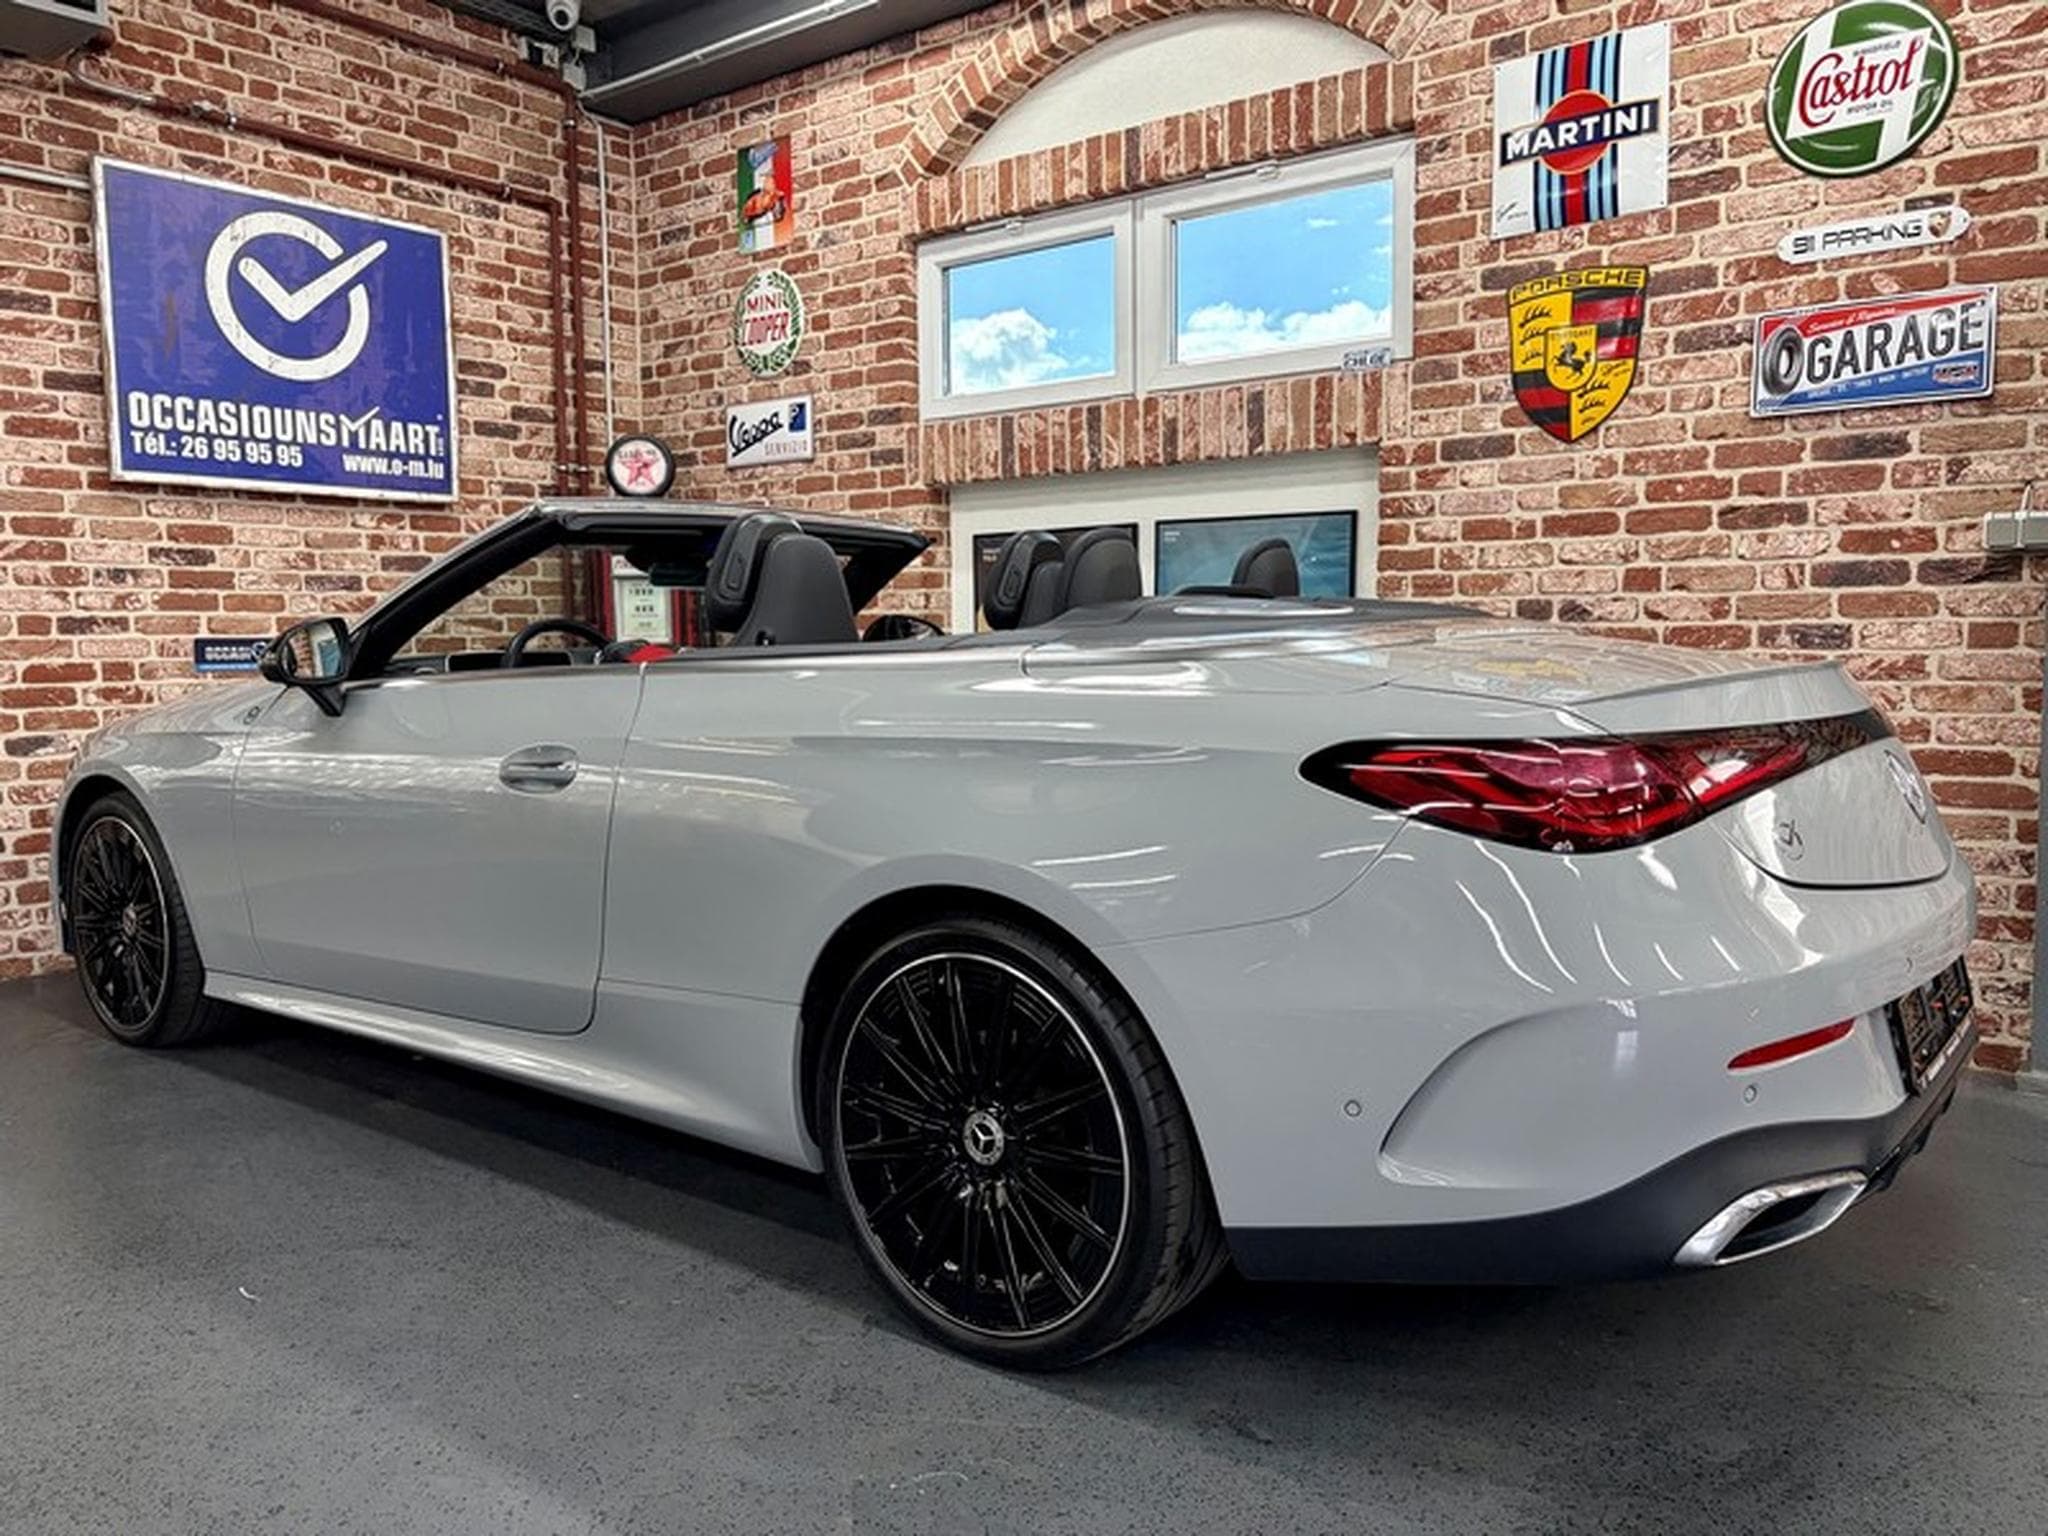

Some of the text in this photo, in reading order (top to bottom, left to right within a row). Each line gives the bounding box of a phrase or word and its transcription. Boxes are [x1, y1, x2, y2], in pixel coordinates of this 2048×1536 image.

[1798, 35, 1924, 128] Castrol
[1506, 104, 1651, 160] MARTINI
[1822, 219, 1922, 250] PARKING
[746, 291, 782, 314] MINI
[1512, 270, 1642, 300] PORSCHE
[741, 311, 789, 347] COOPER
[1806, 299, 1986, 385] GARAGE
[180, 434, 208, 459] 26
[213, 438, 241, 462] 95
[245, 442, 273, 465] 95
[277, 446, 304, 468] 95
[729, 410, 784, 458] Vespa
[343, 453, 444, 480] www.o-m.lu
